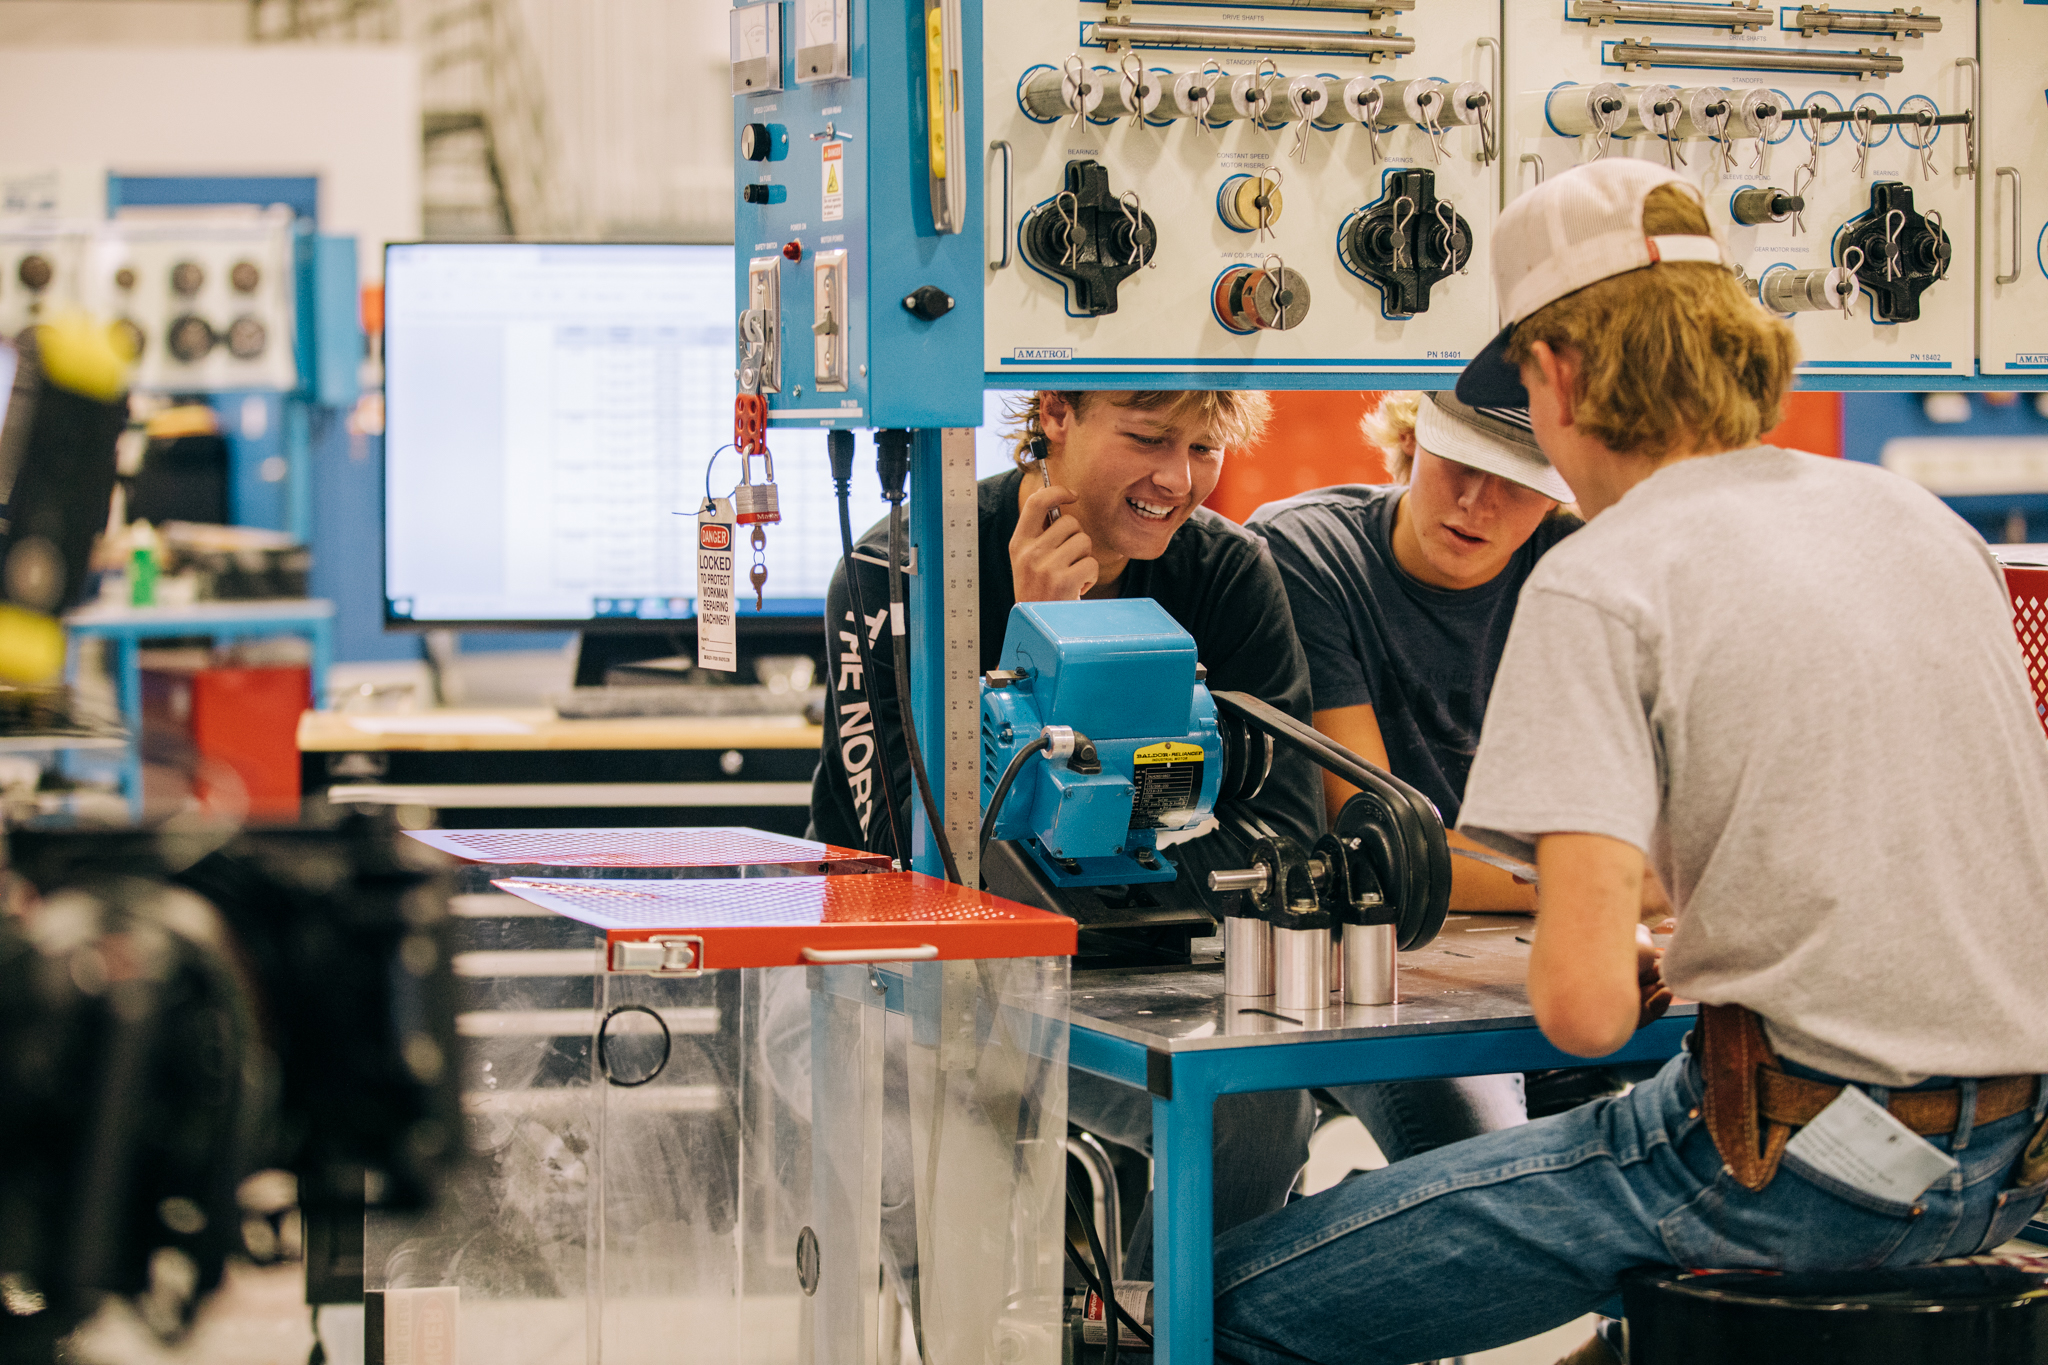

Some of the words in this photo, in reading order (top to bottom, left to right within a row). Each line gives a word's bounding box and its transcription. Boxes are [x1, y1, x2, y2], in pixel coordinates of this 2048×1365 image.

[790, 224, 800, 232] POWER
[755, 243, 766, 251] SAFETY
[766, 242, 777, 250] SWITCH
[1017, 350, 1069, 358] AMATROL
[949, 459, 954, 467] 16
[702, 530, 727, 544] DANGER
[950, 550, 956, 558] 19
[700, 555, 731, 571] LOCKED
[700, 573, 706, 584] TO
[707, 574, 730, 586] PROTECT
[951, 579, 956, 588] 20
[967, 579, 972, 588] 20
[703, 586, 728, 599] WORKMAN
[703, 600, 729, 612] REPAIRING
[951, 609, 956, 618] 21
[968, 609, 972, 617] 21
[702, 613, 730, 626] MACHINERY
[952, 640, 957, 649] 22
[968, 640, 973, 649] 22
[838, 608, 889, 691] THE
[952, 670, 957, 680] 23
[968, 670, 973, 679] 23
[952, 701, 957, 710] 24
[968, 700, 973, 709] 24
[952, 731, 957, 740] 25
[968, 730, 973, 740] 25
[952, 761, 957, 771] 26
[968, 761, 973, 770] 26
[952, 792, 957, 801] 27
[968, 791, 973, 800] 27
[968, 851, 973, 860] 29
